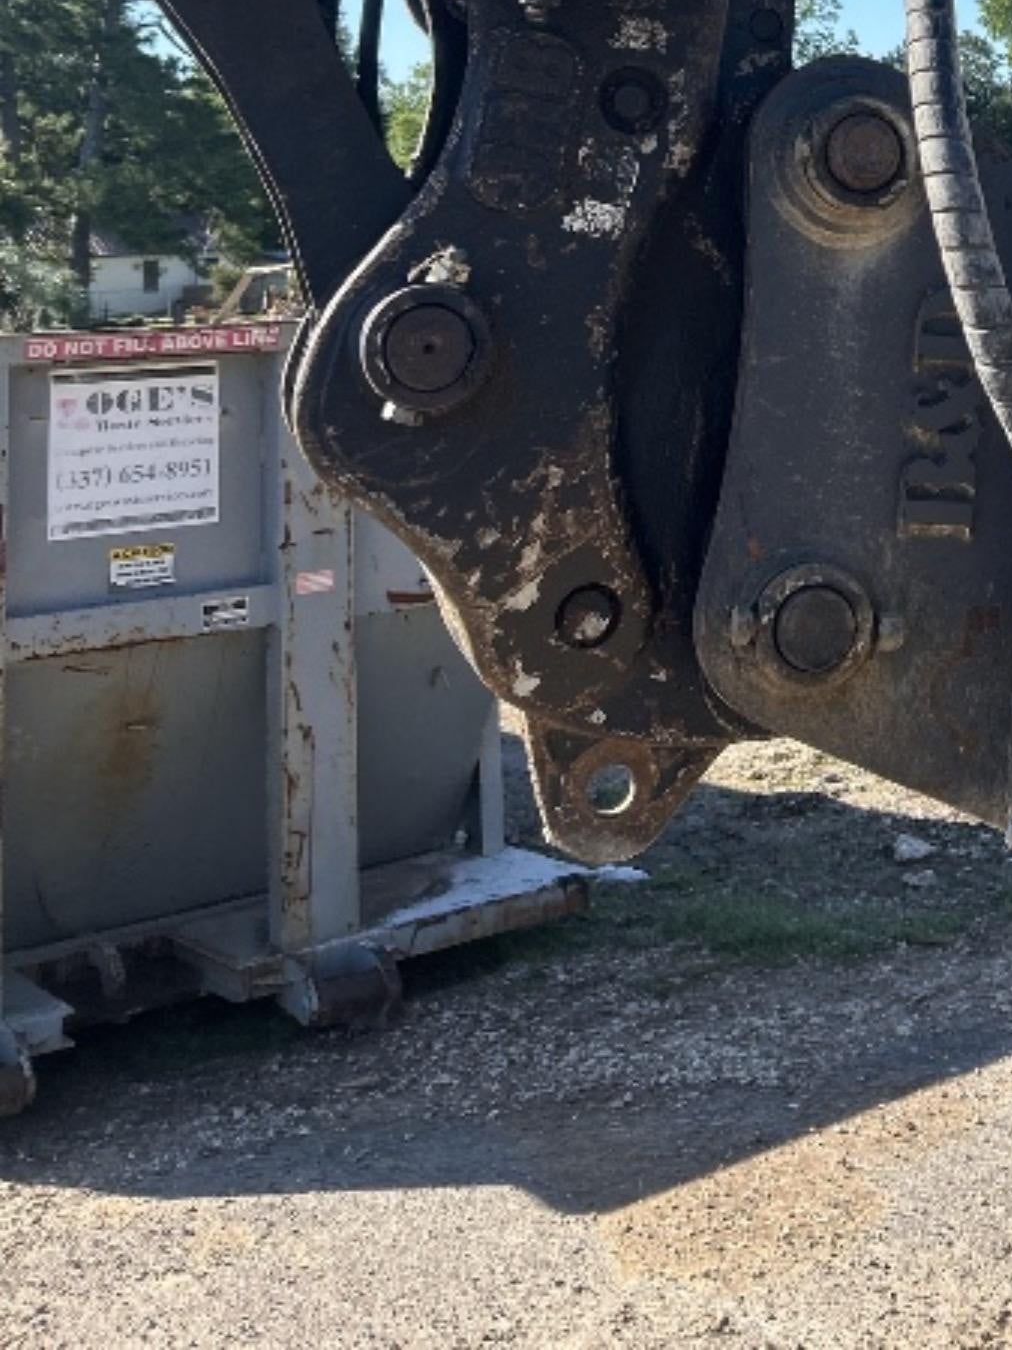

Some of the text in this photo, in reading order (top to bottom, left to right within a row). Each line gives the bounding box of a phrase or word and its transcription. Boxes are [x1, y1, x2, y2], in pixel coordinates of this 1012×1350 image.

[28, 341, 57, 358] DO
[65, 339, 104, 356] NOT
[161, 334, 229, 351] ABOVE
[232, 326, 280, 346] LINE
[119, 458, 211, 485] 654-8951
